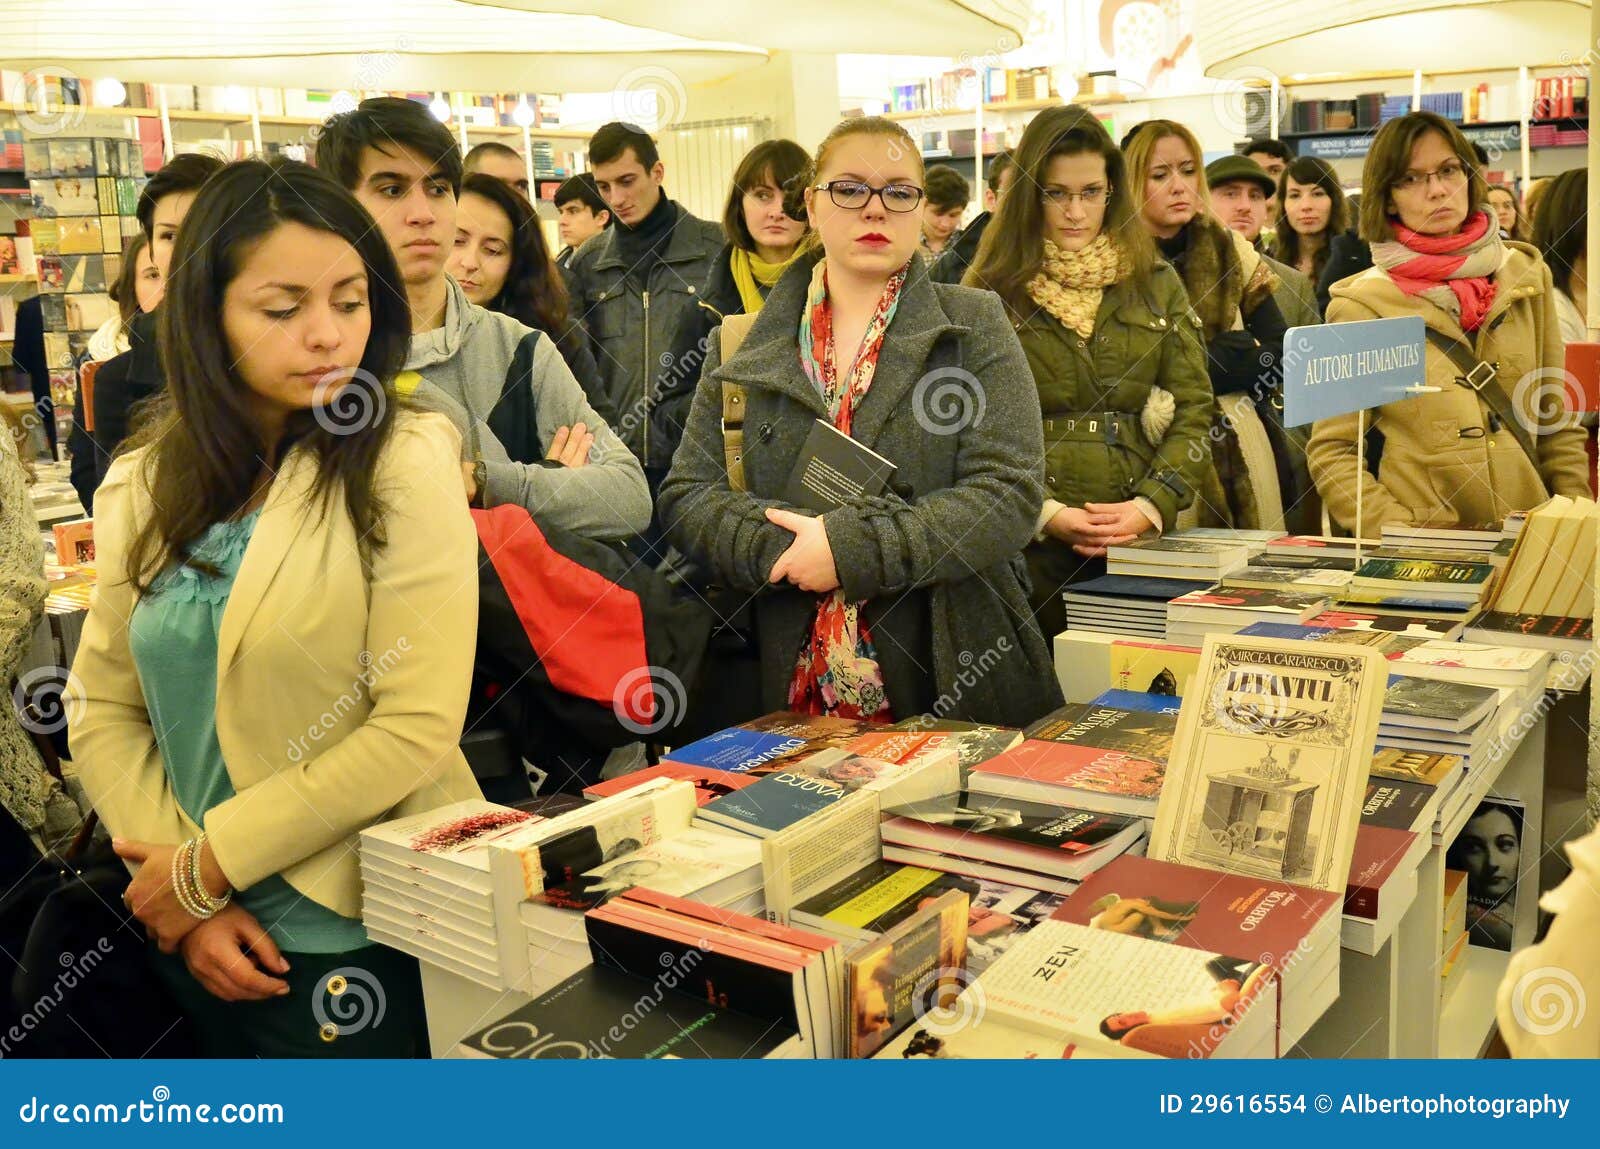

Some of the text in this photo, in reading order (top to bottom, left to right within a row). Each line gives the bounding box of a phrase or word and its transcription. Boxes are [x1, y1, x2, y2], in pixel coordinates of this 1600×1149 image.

[1304, 343, 1420, 386] AUTORI HUMANITAS
[1229, 650, 1272, 664] MIRCEA
[1227, 671, 1334, 702] LEVANTUL
[730, 739, 807, 771] DJUVARA
[1361, 787, 1393, 816] ORBITOR
[1240, 891, 1287, 931] ORBITOR
[1032, 945, 1080, 982] ZEN
